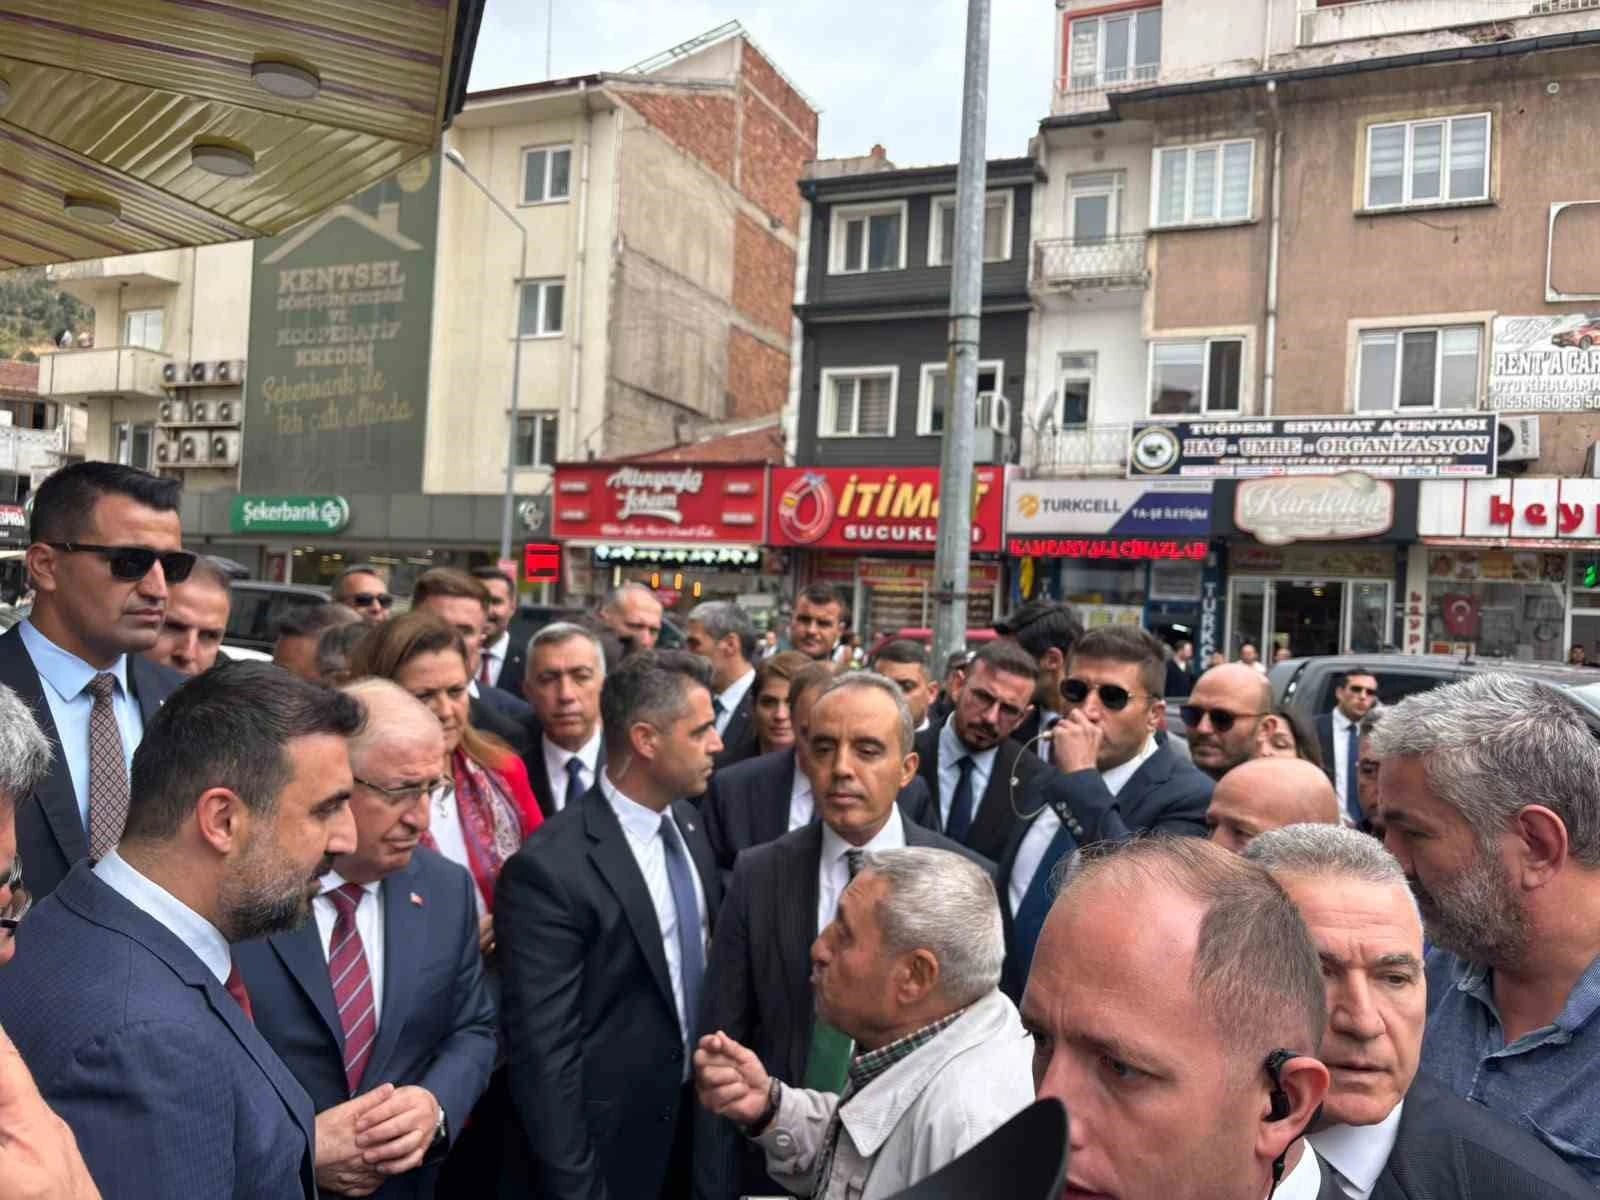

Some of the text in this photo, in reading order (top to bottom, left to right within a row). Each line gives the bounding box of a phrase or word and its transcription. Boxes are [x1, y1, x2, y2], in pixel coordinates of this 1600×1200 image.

[277, 261, 407, 294] KENTSEL
[1567, 351, 1600, 375] CAR
[1284, 420, 1376, 434] SEYAHAT
[1378, 418, 1488, 433] ACENTASI
[1316, 432, 1491, 455] ORGANİZASYON
[243, 500, 320, 527] Şekerbank
[1043, 498, 1122, 513] TURKCELL
[1489, 495, 1600, 535] bey
[844, 524, 981, 542] SUCUKLI
